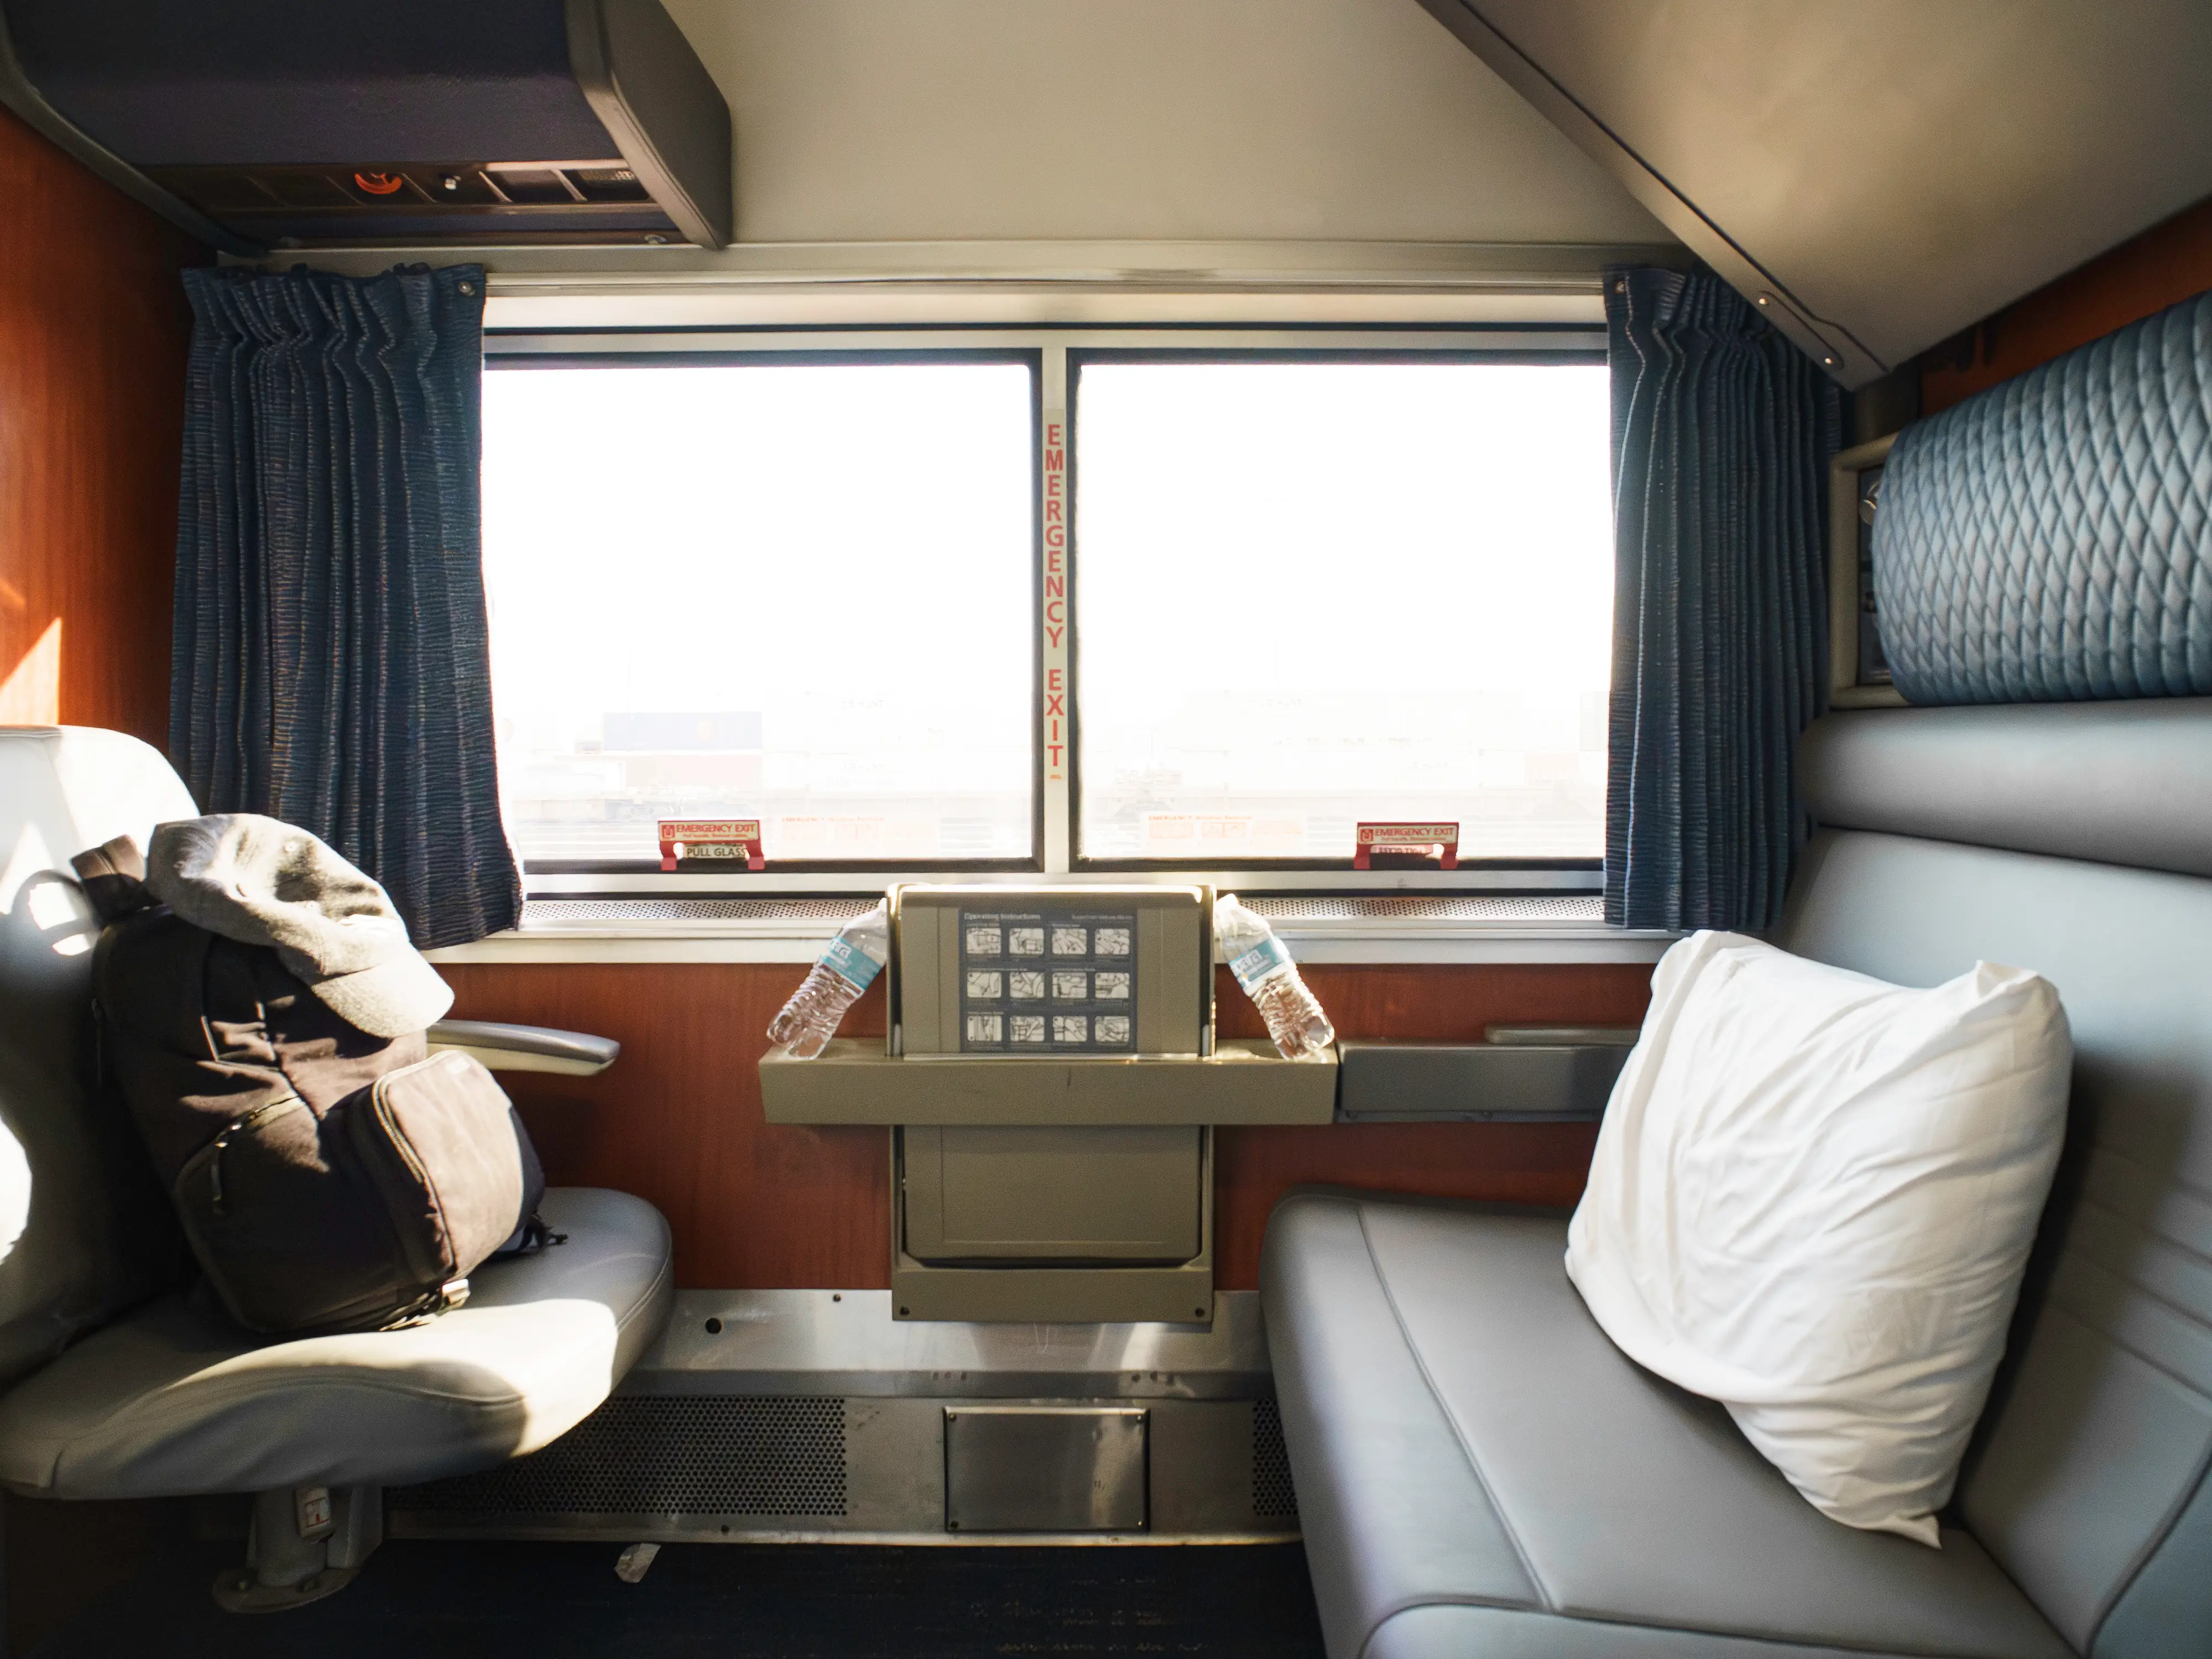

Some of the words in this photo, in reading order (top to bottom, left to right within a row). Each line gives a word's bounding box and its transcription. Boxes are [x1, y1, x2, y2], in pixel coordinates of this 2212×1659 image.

[1046, 424, 1063, 648] EMERGENCY
[1046, 669, 1064, 766] EXIT
[676, 824, 732, 833] EMERGENCY
[734, 823, 756, 832] EXIT
[1375, 828, 1431, 837] EMERGENCY
[1433, 827, 1454, 837] EXIT
[687, 847, 711, 857] PULL
